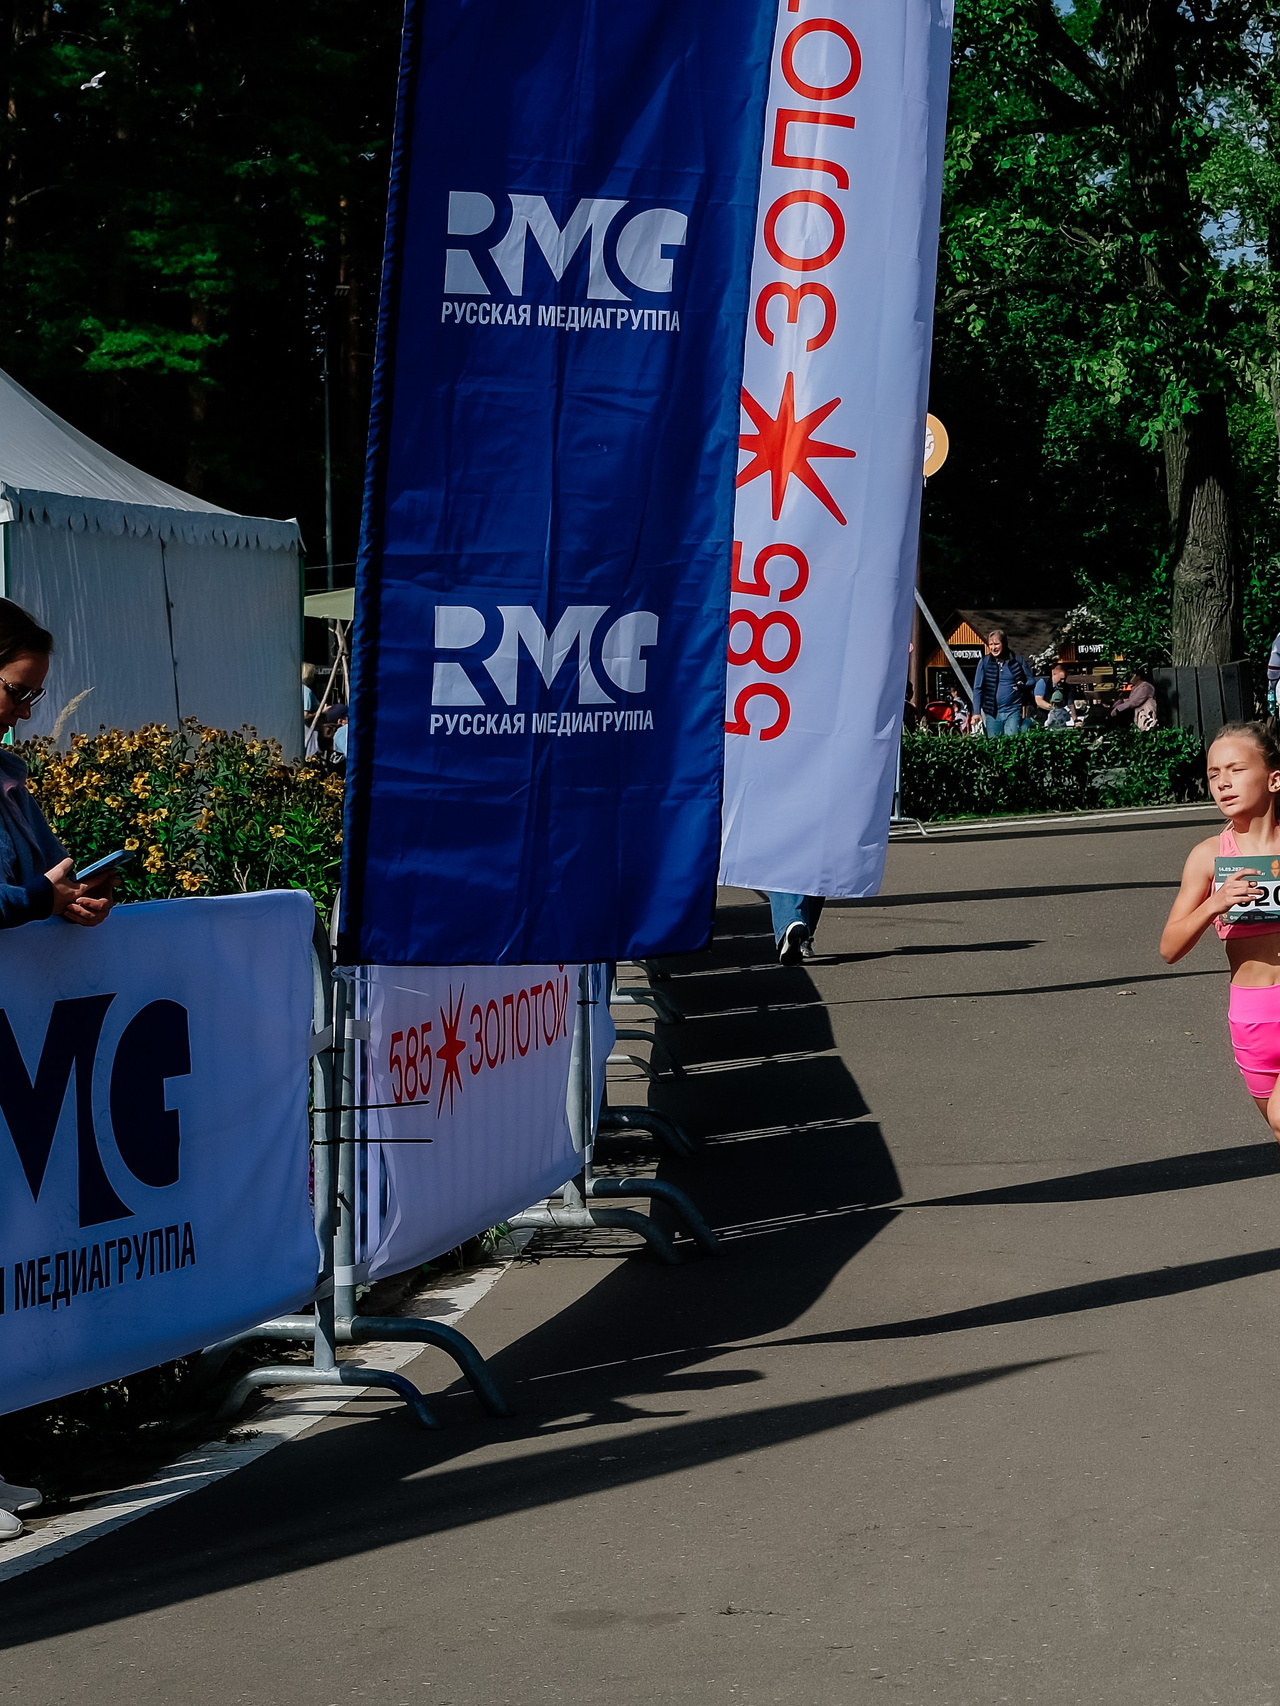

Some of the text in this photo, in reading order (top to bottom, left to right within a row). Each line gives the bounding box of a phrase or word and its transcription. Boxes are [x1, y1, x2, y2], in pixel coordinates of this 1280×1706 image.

[444, 191, 688, 301] RMG
[441, 301, 680, 332] РУССКАЯ МЕДИАГРУППА
[725, 0, 861, 741] 585 ЗОЛО
[431, 605, 659, 706] RMG
[430, 710, 654, 737] РУССКАЯ МЕДИАГРУППА
[390, 965, 568, 1104] 585 ЗОЛОТОЙ
[15, 1221, 196, 1311] МЕДИАГРУППА
